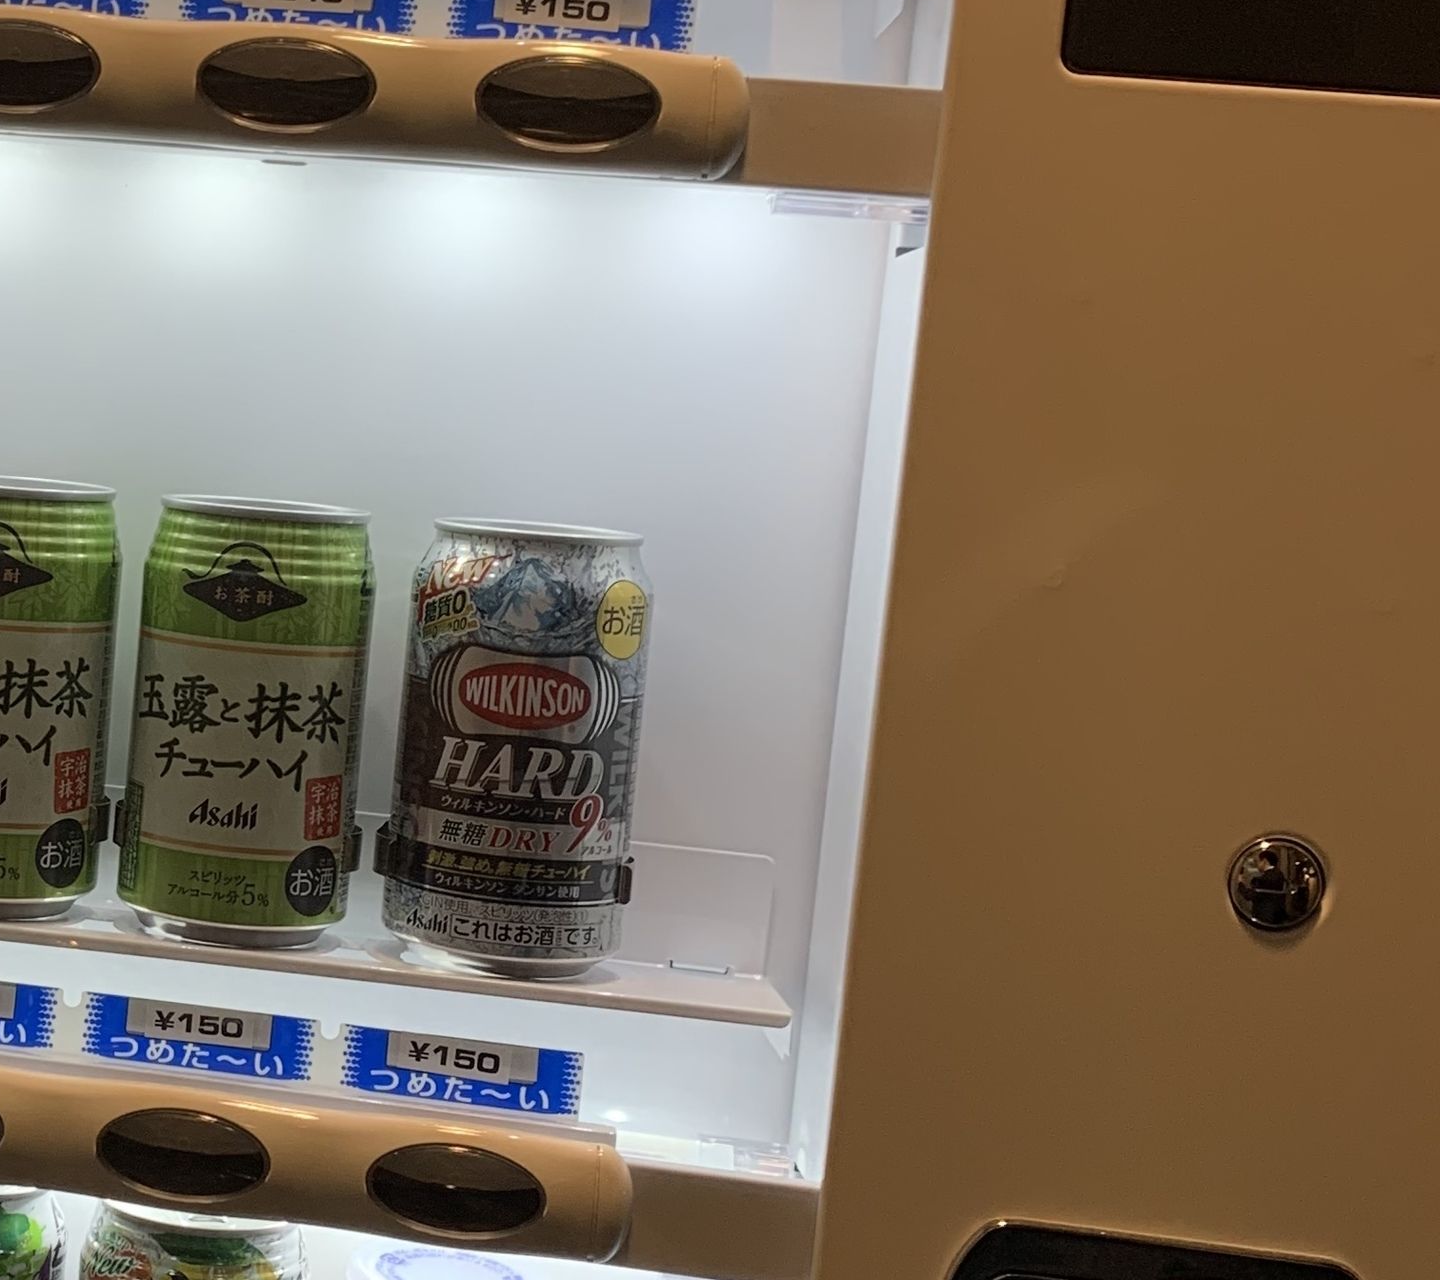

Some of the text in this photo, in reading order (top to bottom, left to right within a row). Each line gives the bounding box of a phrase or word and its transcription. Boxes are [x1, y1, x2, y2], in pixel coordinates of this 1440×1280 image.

[601, 604, 646, 637] お酒
[138, 672, 346, 745] 玉露と抹茶
[464, 674, 585, 718] WILKINSON
[154, 737, 309, 793] チューハイ
[428, 735, 606, 803] HARD
[188, 798, 259, 830] Asahi
[39, 839, 84, 869] お酒
[289, 866, 335, 898] お酒
[406, 907, 449, 935] Asahi
[153, 1009, 245, 1040] ¥150
[407, 1040, 501, 1076] ¥150
